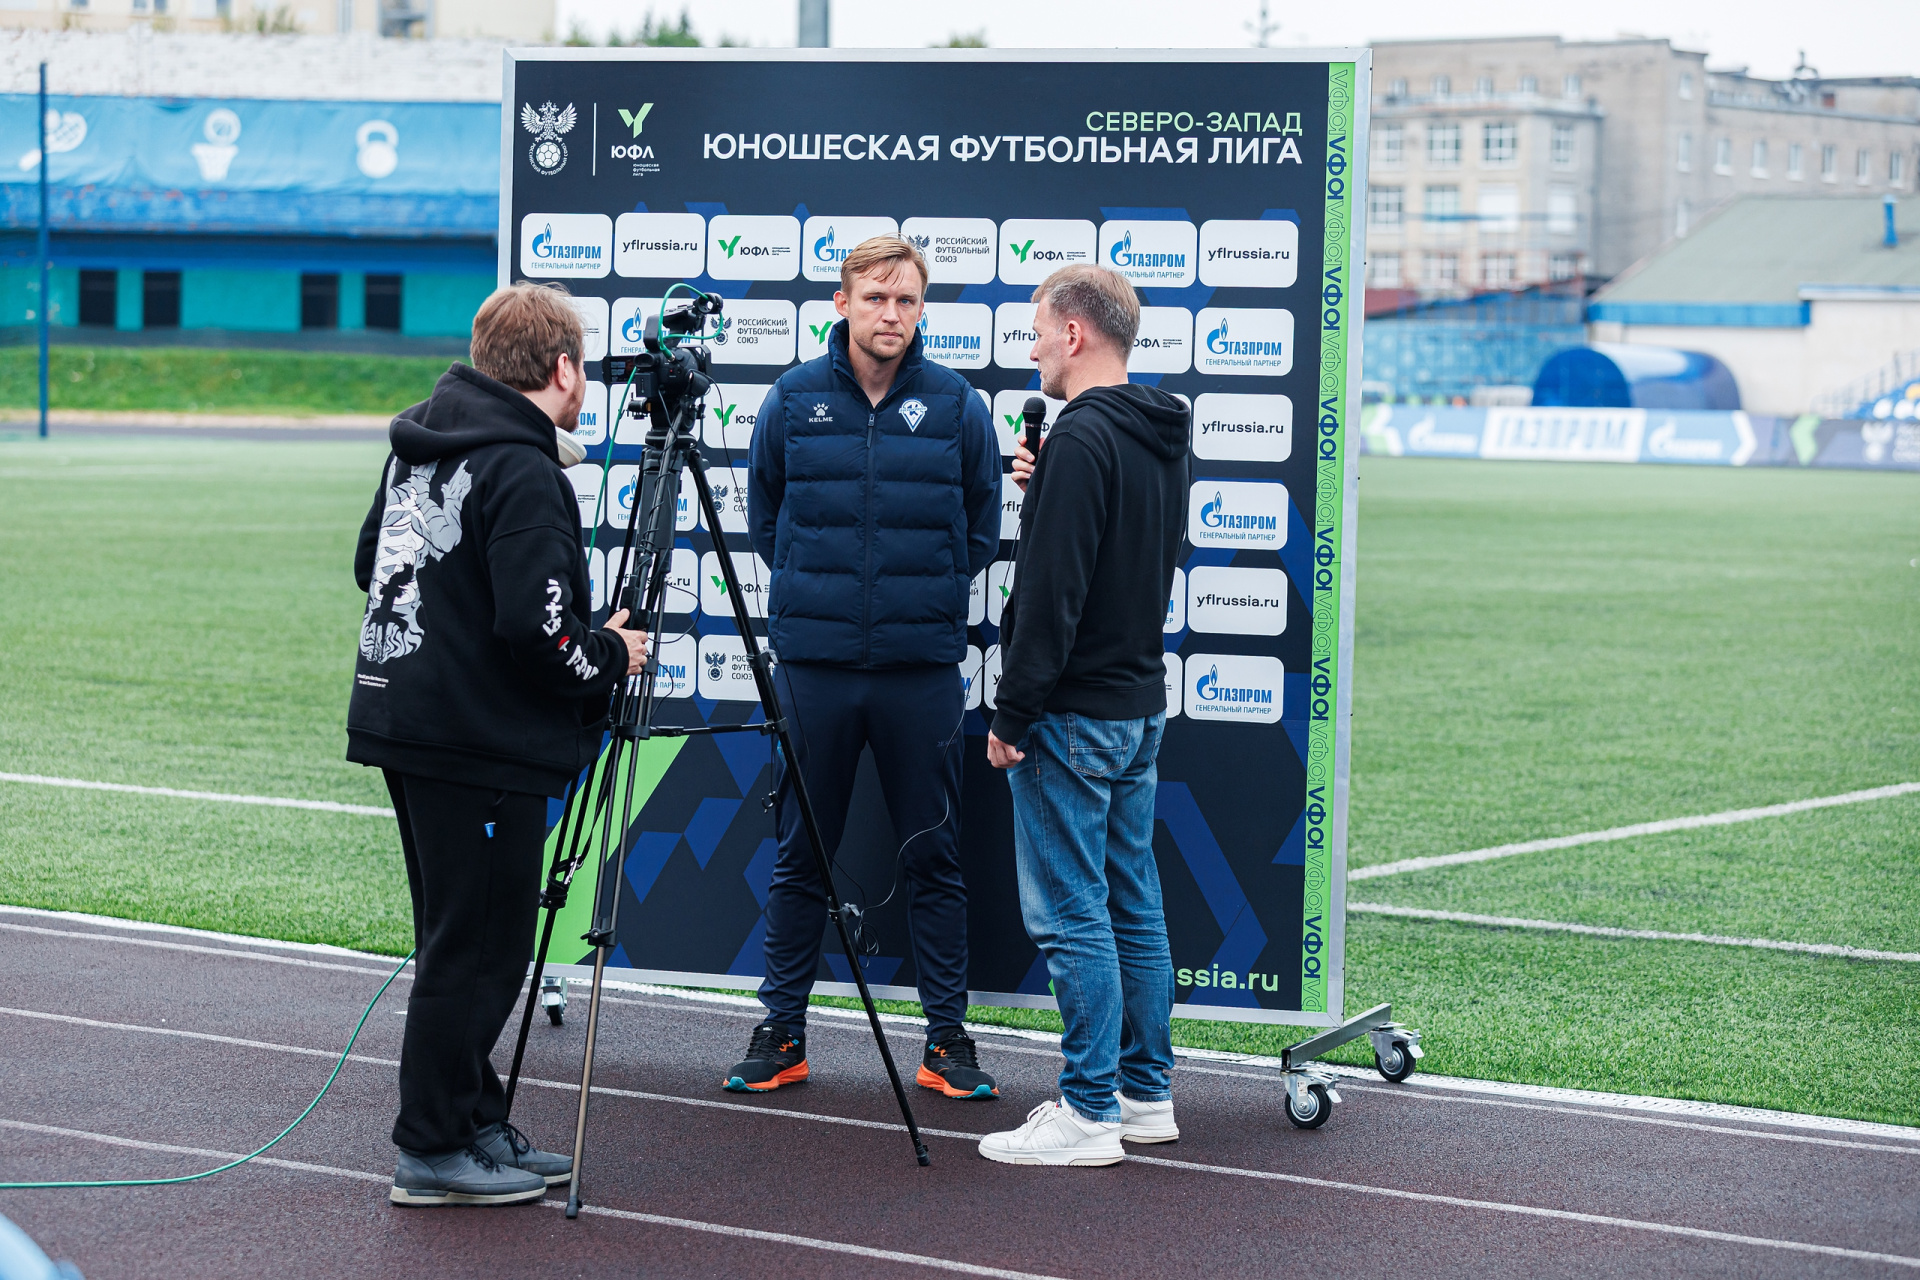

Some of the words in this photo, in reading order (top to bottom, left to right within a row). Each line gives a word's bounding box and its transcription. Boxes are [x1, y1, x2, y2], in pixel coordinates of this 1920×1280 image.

[1086, 111, 1303, 136] СЕВЕРО-ЗАПАД
[611, 144, 655, 160] ЮФЛ
[703, 132, 940, 161] ЮНОШЕСКАЯ
[949, 134, 1198, 165] ФУТБОЛЬНАЯ
[1207, 136, 1303, 165] ЛИГА
[622, 240, 698, 252] yflrussia.ru
[936, 236, 988, 245] РОССИЙСКИЙ
[552, 246, 601, 259] ГАЗПРОМ
[740, 246, 769, 256] ЮФЛ
[935, 246, 990, 254] ФУТБОЛЬНЫЙ
[1033, 250, 1064, 261] ЮФЛ
[1208, 248, 1290, 262] yflrussia.ru
[935, 255, 957, 263] СОЮЗ
[1132, 254, 1185, 268] ГАЗПРОМ
[738, 318, 788, 326] РОССИЙСКИЙ
[737, 328, 790, 336] ФУТБОЛЬНЫЙ
[737, 336, 758, 344] СОЮЗ
[929, 335, 980, 350] ГАЗПРОМ
[1229, 342, 1282, 356] ГАЗПРОМ
[924, 352, 951, 360] АЛЬНЫЙ
[1206, 358, 1252, 366] ГЕНЕРАЛЬНЫЙ
[1253, 359, 1282, 367] ПАРТНЕР
[735, 415, 757, 425] ЮФ
[1202, 420, 1284, 434] yflrussia.ru
[1223, 514, 1277, 530] ГАЗПРОМ
[1200, 532, 1246, 540] ГЕНЕРАЛЬНЫЙ
[1196, 594, 1279, 608] yflrussia.ru
[732, 672, 752, 680] СОЮЗ
[1220, 688, 1272, 704] ГАЗПРОМ
[1196, 704, 1242, 713] ГЕНЕРАЛЬНЫЙ
[1244, 706, 1272, 714] ПАРТНЕР
[1175, 964, 1279, 992] ssia.ru
